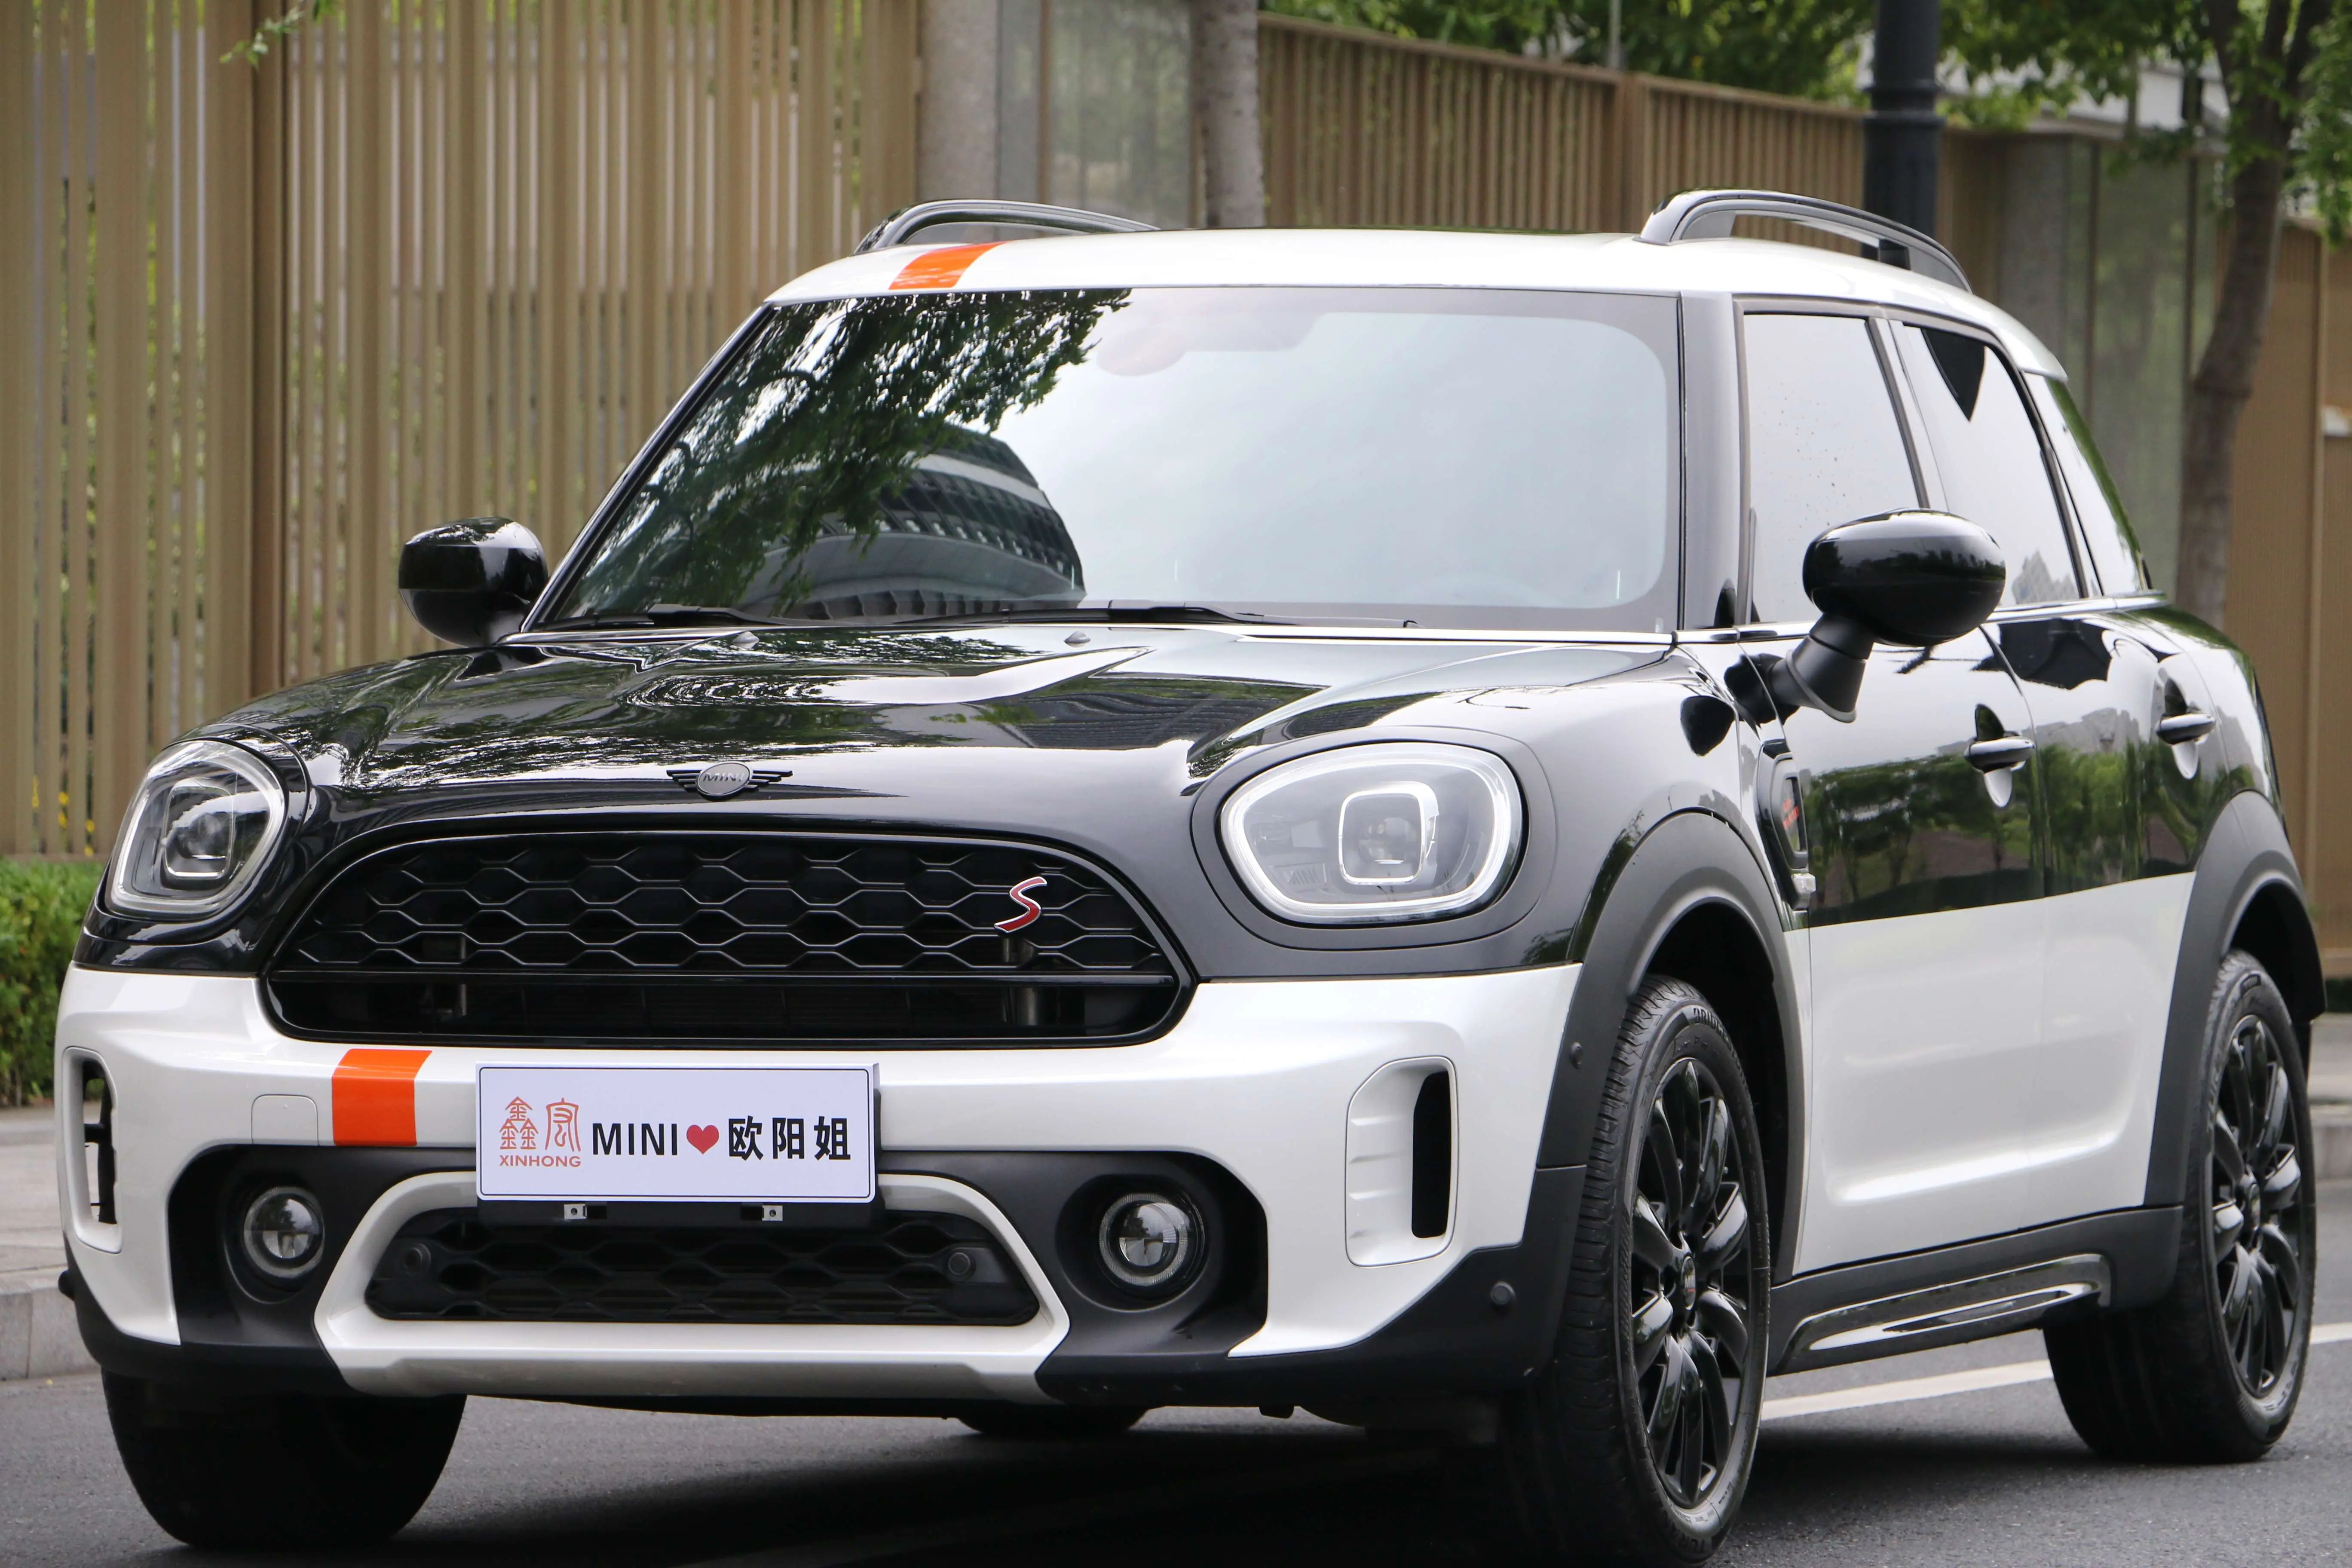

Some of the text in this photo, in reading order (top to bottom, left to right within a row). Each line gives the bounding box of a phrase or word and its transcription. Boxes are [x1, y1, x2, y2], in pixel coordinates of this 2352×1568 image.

[703, 772, 743, 782] MINI
[994, 876, 1047, 933] S
[593, 1116, 851, 1161] MINI 欧阳姐
[499, 1155, 581, 1167] XINHONG
